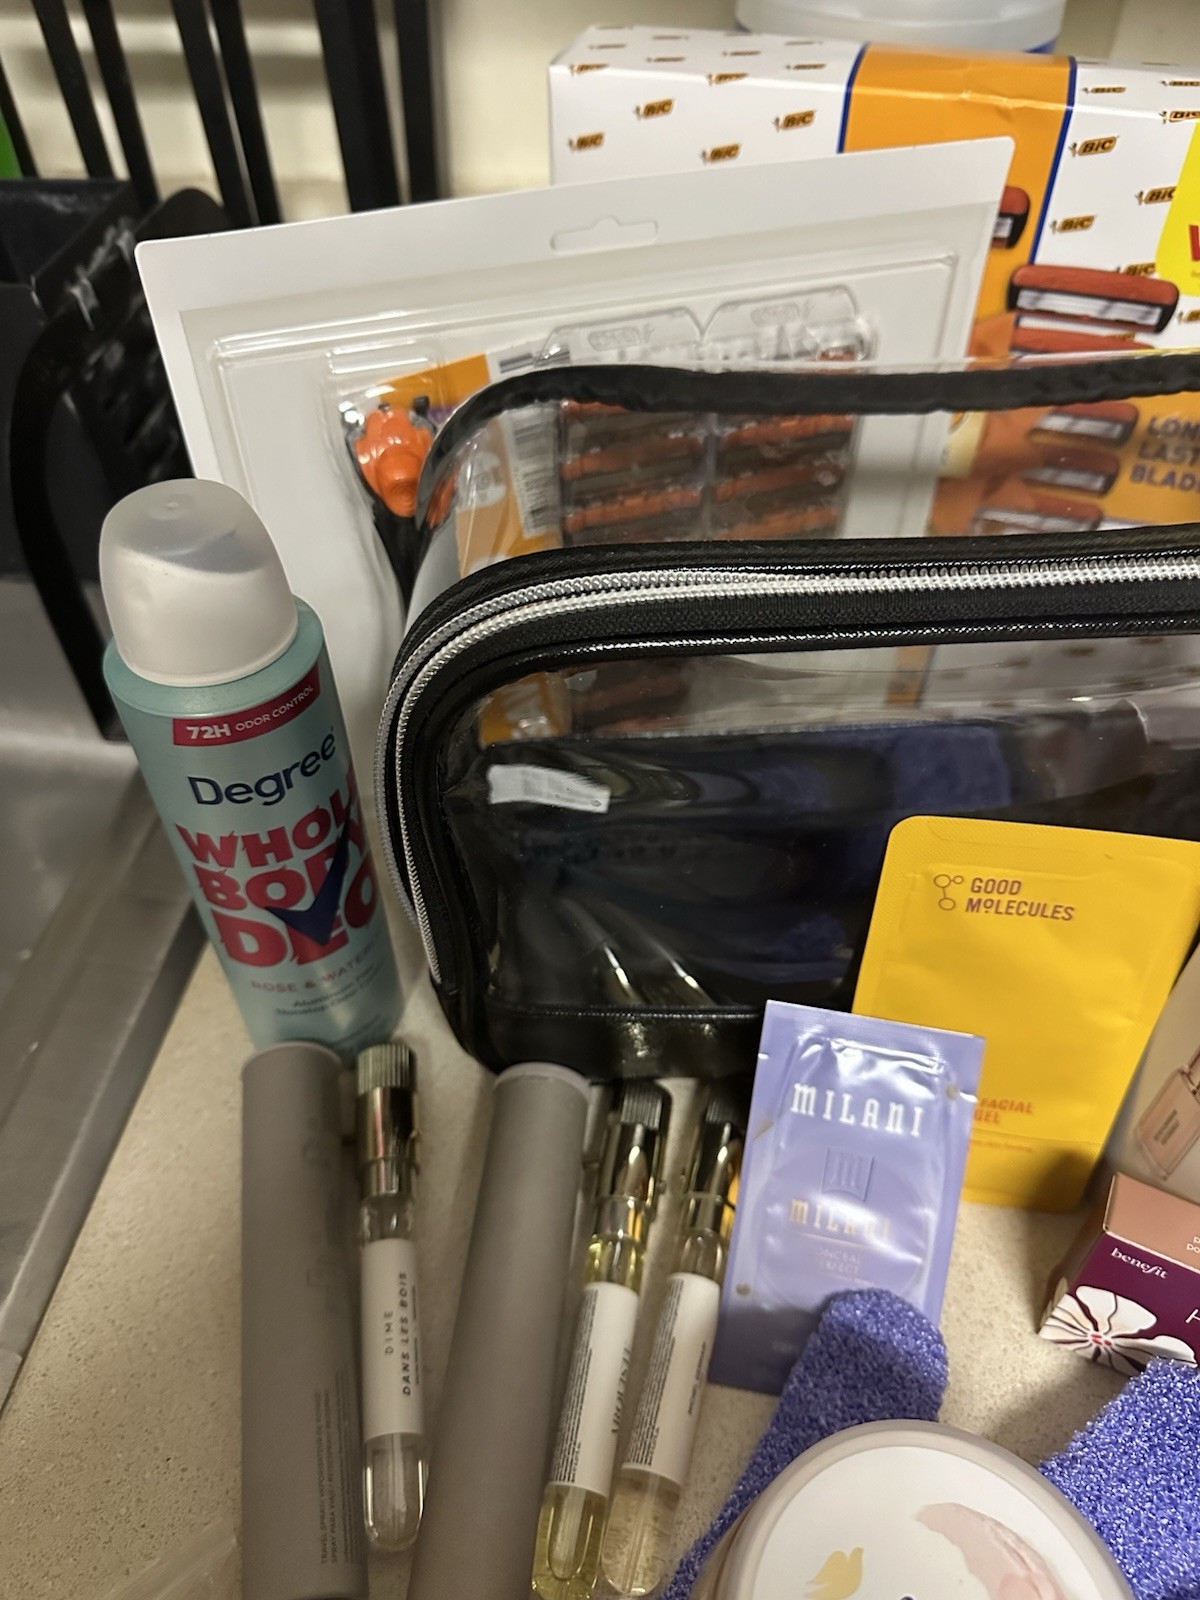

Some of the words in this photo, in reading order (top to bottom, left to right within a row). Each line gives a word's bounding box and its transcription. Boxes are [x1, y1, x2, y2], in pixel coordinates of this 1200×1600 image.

[1082, 137, 1116, 154] BIC
[1130, 462, 1200, 491] BLAD
[186, 722, 231, 740] 72H
[235, 712, 271, 732] ODOR
[272, 684, 314, 718] CONTROL
[187, 733, 337, 806] Degree
[970, 878, 1022, 895] GOOD
[790, 1083, 924, 1137] MILANI
[973, 1109, 1000, 1124] GEL
[979, 1097, 1034, 1114] FACIAL
[1110, 1248, 1169, 1280] benefit
[399, 1272, 408, 1308] BOIS
[384, 1310, 394, 1355] DIME
[400, 1316, 409, 1344] LES
[401, 1352, 411, 1395] DANS
[321, 1533, 329, 1564] TRAVEL
